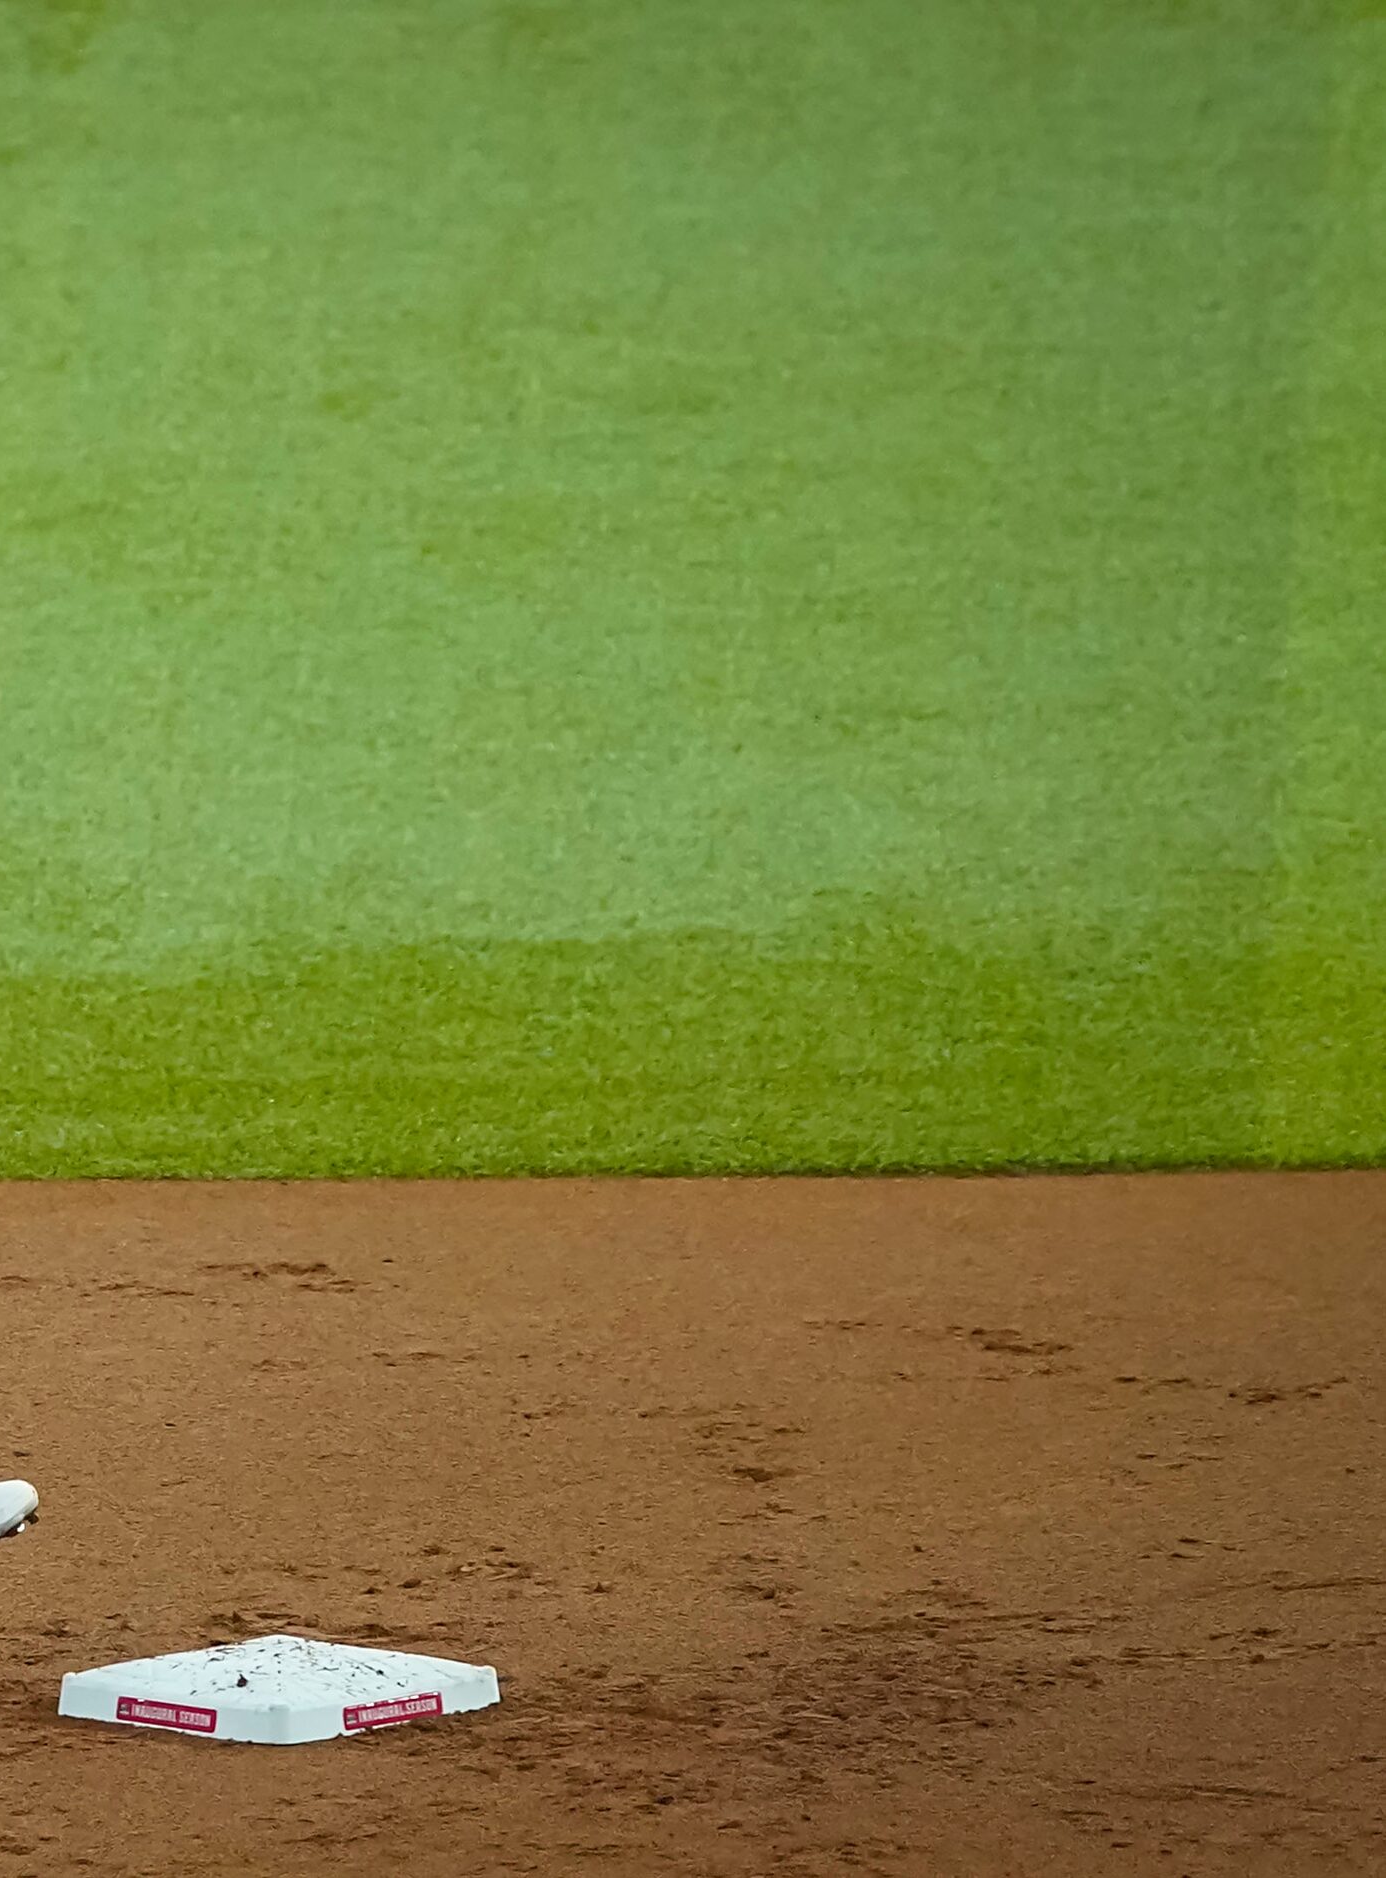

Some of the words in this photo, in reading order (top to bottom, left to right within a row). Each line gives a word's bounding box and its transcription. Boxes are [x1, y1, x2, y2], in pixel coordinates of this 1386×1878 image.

[131, 1703, 177, 1722] INAUGURAL
[178, 1710, 212, 1728] SEASON
[358, 1704, 404, 1723] INAUGURAL
[405, 1697, 438, 1713] SEASON
